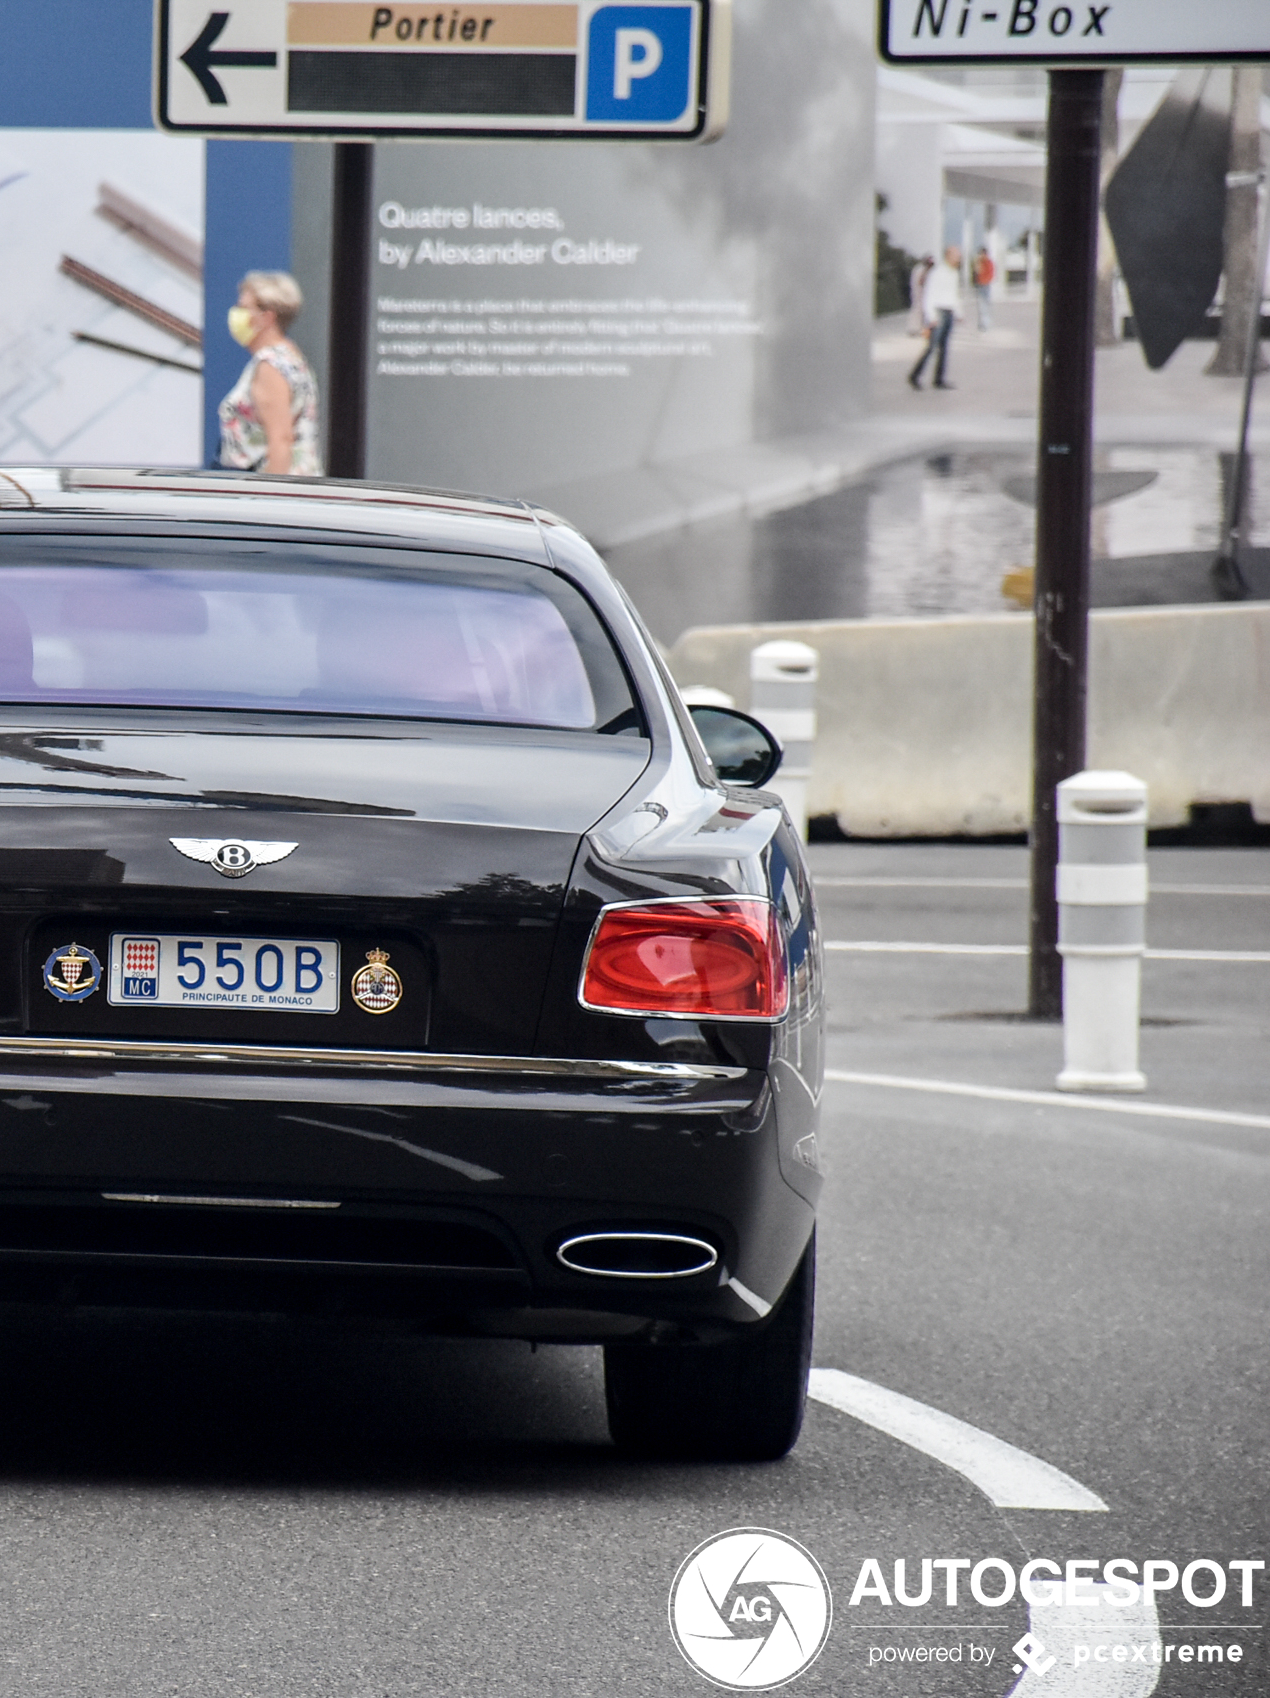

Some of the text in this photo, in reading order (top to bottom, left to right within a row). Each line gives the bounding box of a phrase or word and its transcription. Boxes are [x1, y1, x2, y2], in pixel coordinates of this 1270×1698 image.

[371, 9, 495, 42] Portier
[913, 0, 1111, 37] Ni-Box
[613, 27, 663, 99] P
[378, 201, 563, 231] Quatre lances,
[379, 238, 639, 269] by Alexander Calder
[176, 941, 323, 994] 550B
[129, 979, 151, 996] MC
[182, 992, 313, 1006] PRINCIPAUTE DE MONACO
